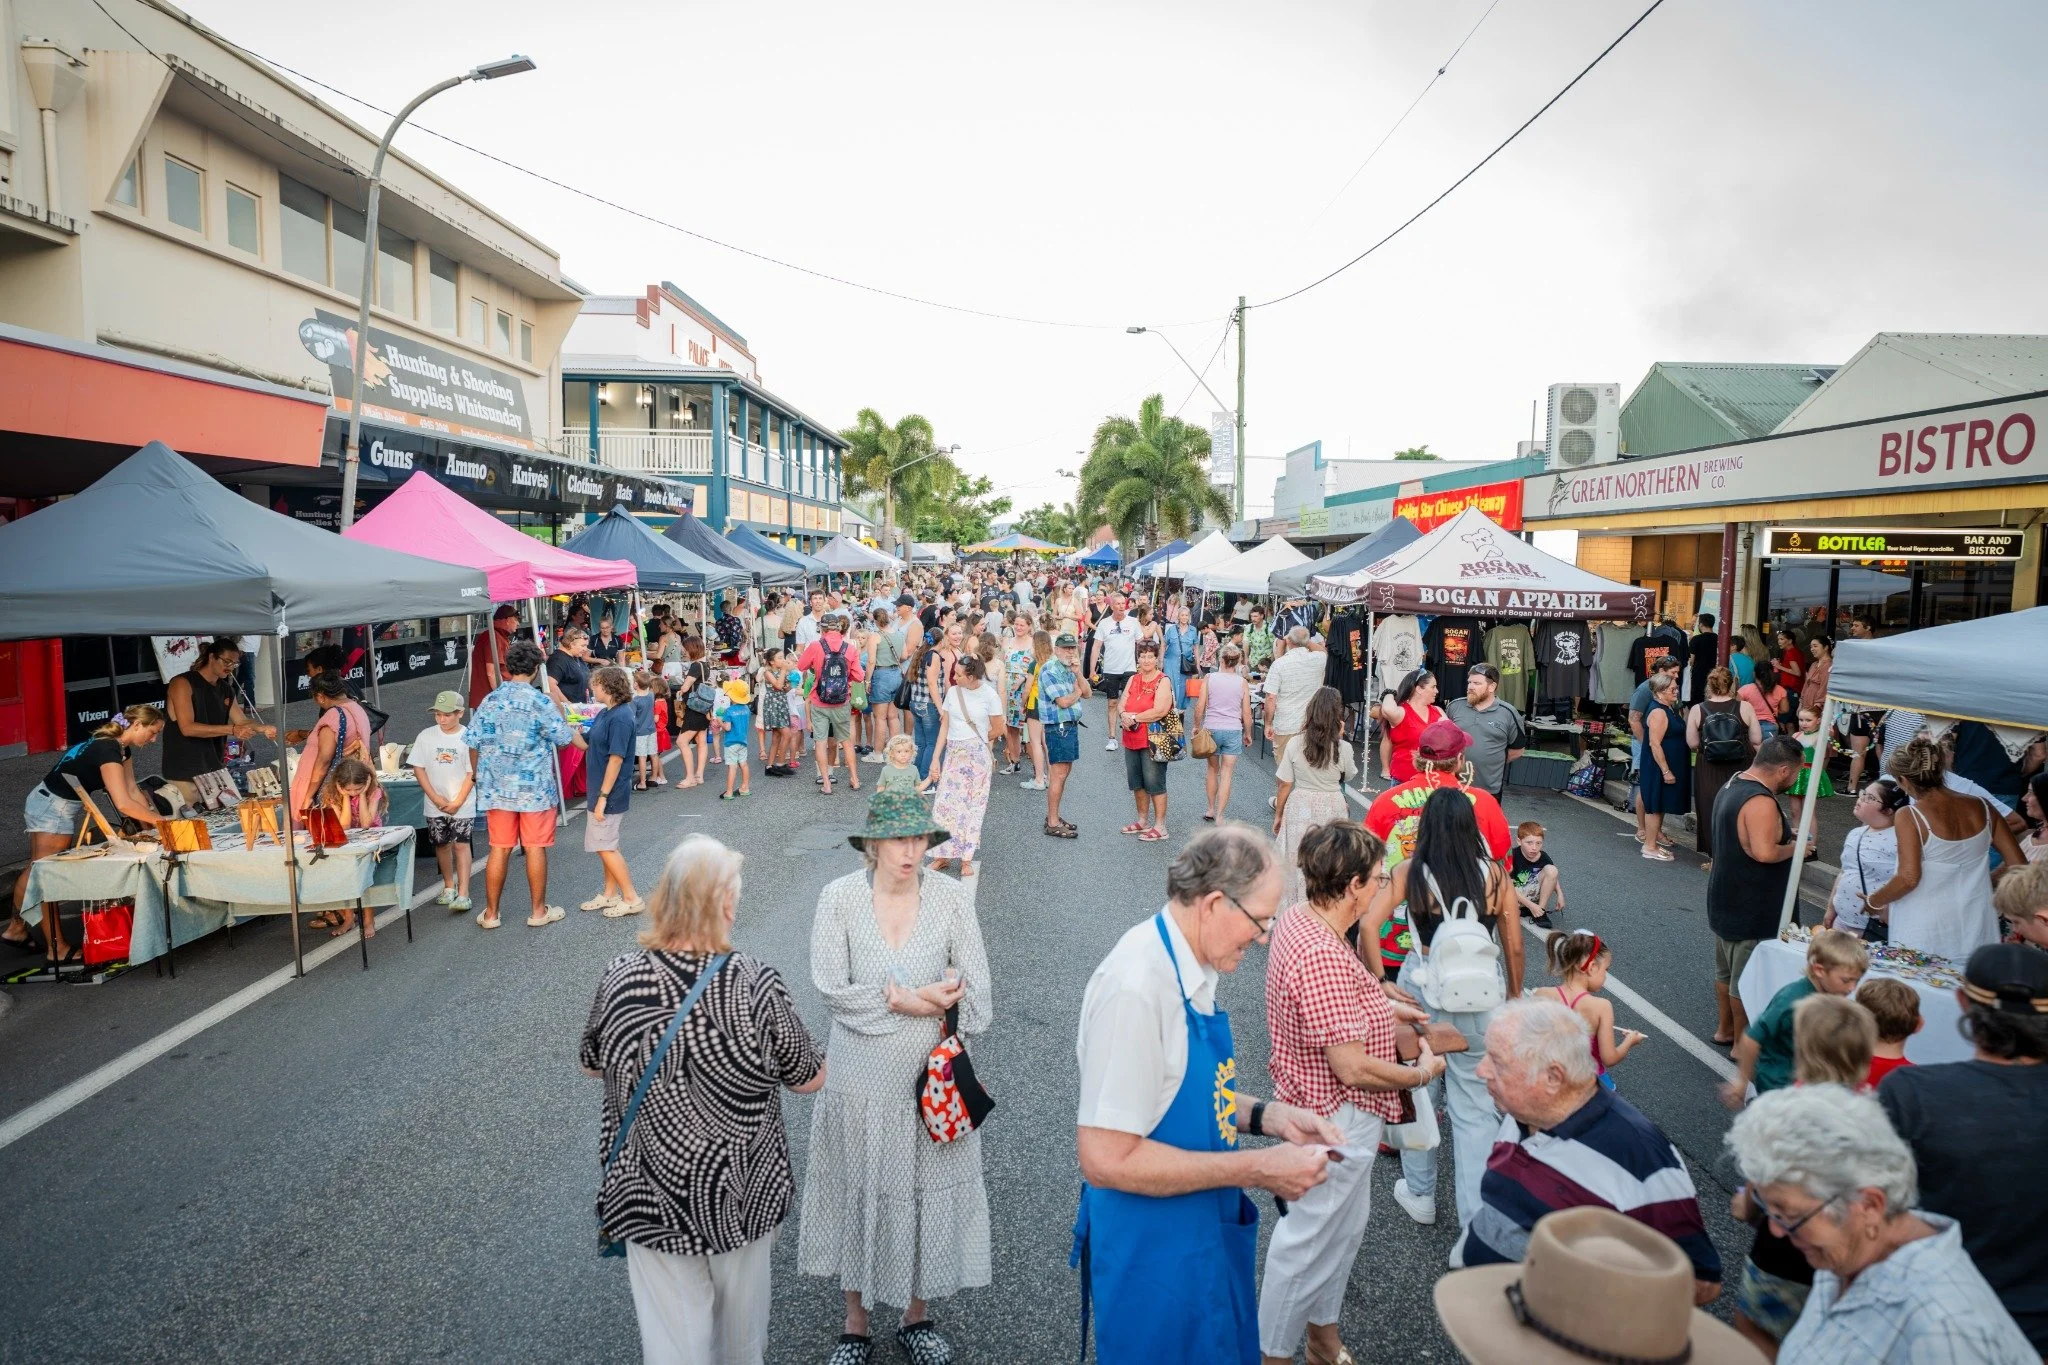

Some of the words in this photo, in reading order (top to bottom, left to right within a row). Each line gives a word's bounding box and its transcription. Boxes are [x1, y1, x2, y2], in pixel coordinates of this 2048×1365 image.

[385, 344, 448, 386] Hunting
[450, 366, 462, 386] &
[462, 369, 514, 407] Shooting
[389, 375, 454, 412] Supplies
[454, 394, 522, 432] Whitsunday
[1222, 426, 1231, 446] YEAR
[1879, 412, 2036, 476] BISTRO
[1214, 434, 1222, 456] HAPPY
[370, 440, 414, 469] Guns
[1222, 448, 1231, 464] NEW
[446, 453, 487, 480] Ammo
[1704, 456, 1744, 474] BREWING
[512, 464, 548, 488] Knives
[1572, 476, 1612, 503] GREAT
[1615, 462, 1700, 498] NORTHERN
[1711, 476, 1726, 488] CO.
[568, 474, 604, 500] Clothing
[616, 484, 632, 501] Hats
[644, 488, 662, 504] Boots
[296, 510, 332, 519] Hunting
[1420, 501, 1435, 518] Star
[1436, 499, 1464, 517] Chinese
[1818, 536, 1885, 551] BOTTLER
[1964, 536, 1986, 545] BAR
[1988, 536, 2012, 545] AND
[1968, 546, 2005, 555] BISTRO
[1460, 560, 1530, 570] BOGAN
[1460, 567, 1546, 578] APPAREL
[1418, 588, 1500, 606] BOGAN
[1506, 590, 1607, 611] APPAREL
[1508, 609, 1532, 617] Bogan
[344, 666, 364, 680] UGER
[382, 662, 400, 674] SPIKA
[78, 710, 108, 722] Vixen
